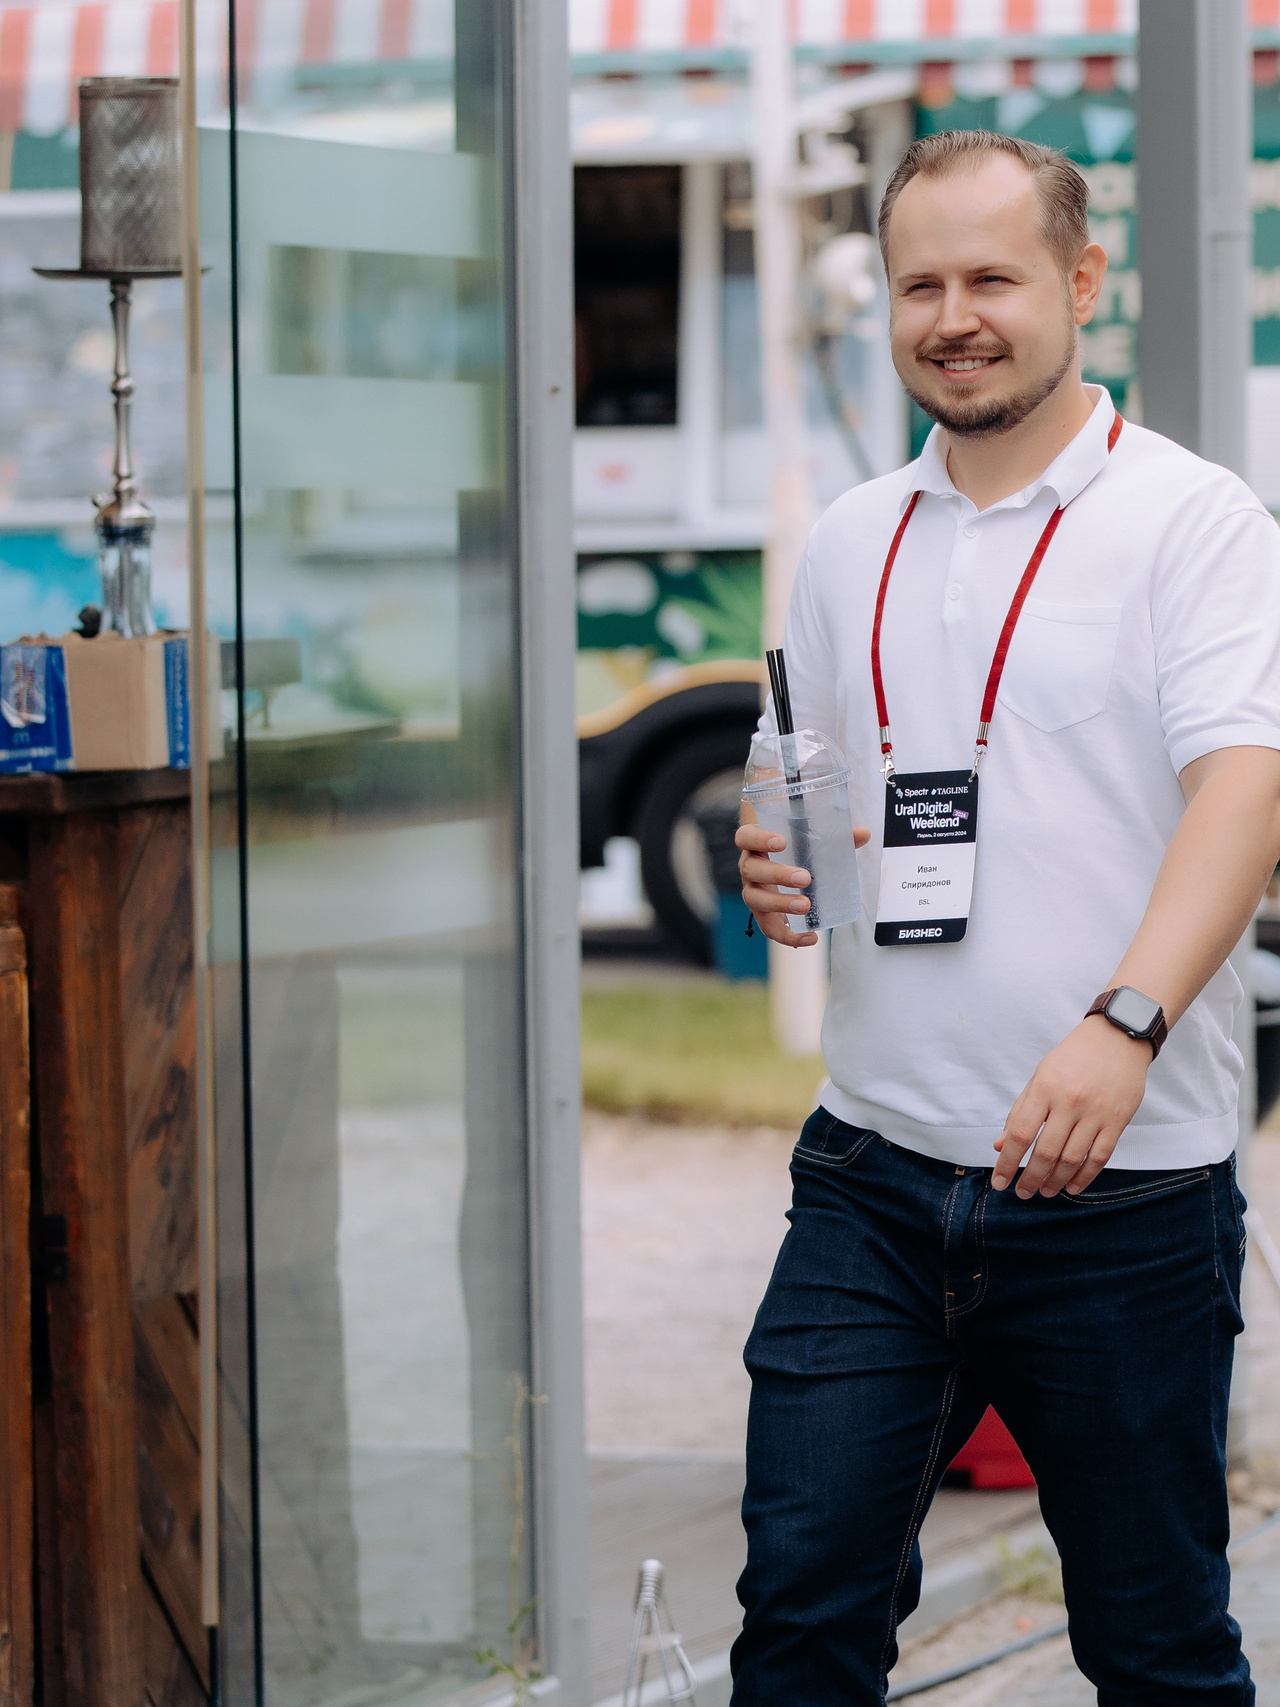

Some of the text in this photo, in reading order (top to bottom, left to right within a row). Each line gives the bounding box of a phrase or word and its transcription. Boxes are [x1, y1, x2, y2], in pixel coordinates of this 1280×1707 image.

[904, 786, 968, 797] Spectr TAGLINE
[894, 801, 952, 817] Ural Digital
[954, 810, 967, 818] 2024
[910, 816, 959, 829] Weekend
[917, 865, 937, 873] Иван
[901, 879, 951, 890] Спиридонов
[918, 898, 930, 906] BSL
[898, 927, 943, 939] БИЗНЕС
